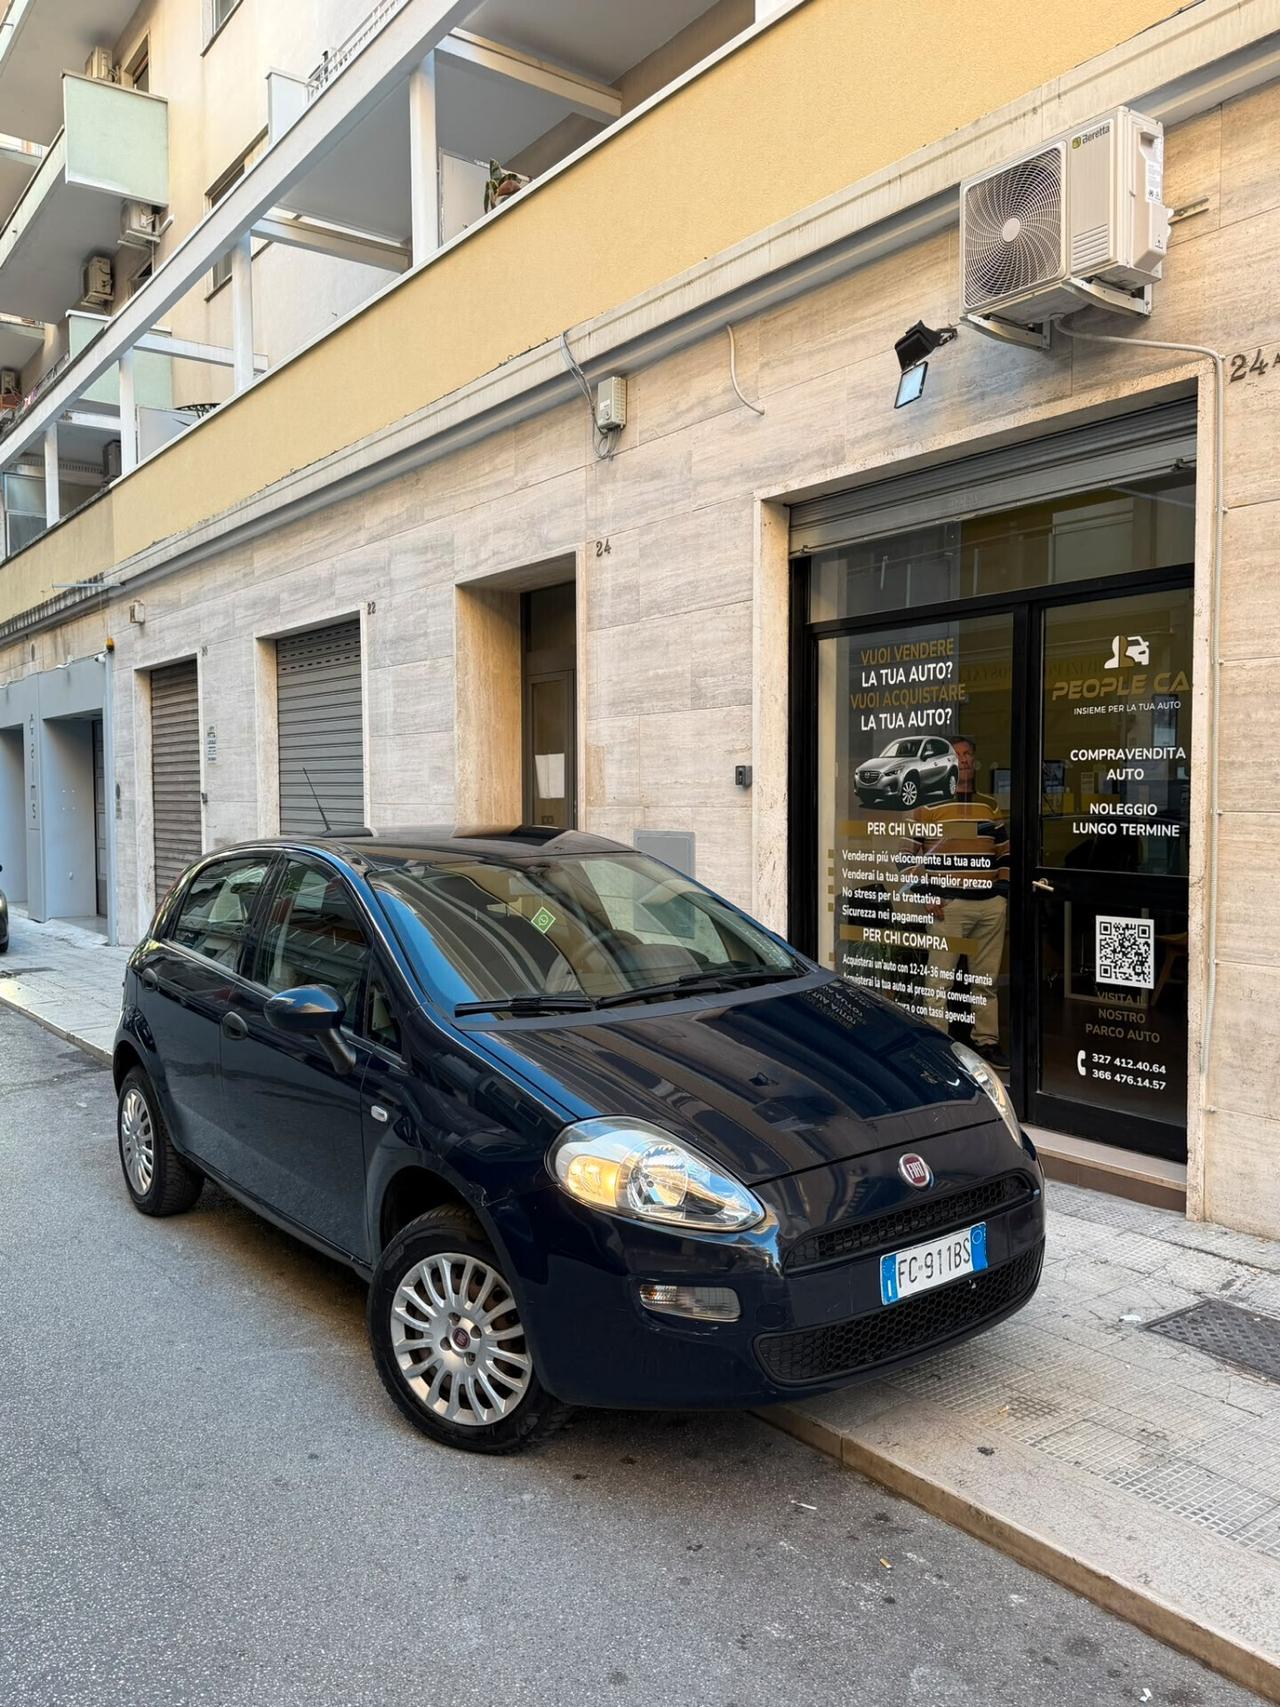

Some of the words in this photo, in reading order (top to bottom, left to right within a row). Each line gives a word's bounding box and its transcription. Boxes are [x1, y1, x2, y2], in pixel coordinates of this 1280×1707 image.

[1082, 125, 1111, 145] Beretta
[596, 538, 611, 557] 24
[367, 601, 376, 615] 22
[861, 647, 890, 666] VUOI
[894, 638, 954, 661] VENDERE
[862, 671, 877, 687] LA
[880, 668, 905, 685] TUA
[909, 661, 953, 682] AUTO?
[851, 692, 879, 710] VUOI
[883, 683, 966, 709] ACQUISTARE
[1052, 674, 1148, 700] PEOPLE
[1074, 705, 1106, 715] INSIEME
[1108, 704, 1124, 713] PER
[1127, 703, 1137, 712] LA
[1139, 702, 1155, 711] TUA
[1157, 701, 1181, 710] AUTO
[861, 714, 876, 730] LA
[879, 712, 905, 730] TUA
[908, 708, 952, 728] AUTO?
[1070, 747, 1186, 761] COMPRAVENDITA
[1106, 768, 1144, 780] AUTO
[1089, 803, 1158, 816] NOLEGGIO
[867, 822, 886, 835] PER
[888, 822, 906, 836] CHI
[908, 823, 943, 837] VENDE
[1072, 822, 1117, 835] LUNGO
[1120, 823, 1180, 837] TERMINE
[842, 849, 875, 862] Venderai
[890, 853, 941, 865] velocemente
[943, 854, 951, 866] la
[953, 856, 968, 867] tua
[970, 857, 991, 868] auto
[842, 868, 875, 880] Venderai
[876, 870, 884, 881] la
[885, 871, 898, 882] tua
[900, 873, 919, 884] auto
[920, 874, 929, 885] al
[930, 875, 961, 888] miglior
[963, 878, 992, 890] prezzo
[842, 887, 853, 897] No
[854, 888, 876, 900] stress
[878, 891, 890, 902] per
[892, 890, 900, 901] la
[902, 891, 941, 905] trattativa
[842, 904, 876, 918] Sicurezza
[878, 908, 890, 920] nei
[891, 912, 934, 925] pagamenti
[863, 928, 881, 943] PER
[883, 930, 900, 945] CHI
[902, 933, 949, 951] COMPRA
[842, 953, 874, 968] Acquisterai
[874, 958, 897, 972] un'auto
[897, 963, 908, 973] con
[909, 963, 939, 978] 12-24-36
[939, 968, 955, 980] mesi
[955, 969, 963, 981] di
[963, 972, 993, 987] garanzia
[874, 976, 881, 988] la
[881, 978, 891, 989] tua
[892, 981, 905, 992] auto
[906, 982, 914, 994] al
[914, 986, 935, 999] prezzo
[947, 991, 987, 1006] conveniente
[1097, 991, 1133, 1006] VISITA
[911, 1004, 916, 1014] o
[916, 1005, 928, 1016] con
[928, 1006, 944, 1018] tassi
[944, 1010, 976, 1025] agevolati
[1098, 1008, 1146, 1024] NOSTRO
[1085, 1023, 1125, 1038] PARCO
[1127, 1030, 1160, 1043] AUTO
[1092, 1053, 1111, 1064] 327
[1113, 1057, 1167, 1074] 412.40.64
[1092, 1069, 1112, 1080] 366
[1113, 1073, 1167, 1090] 476.14.57
[906, 1161, 925, 1179] FIAT
